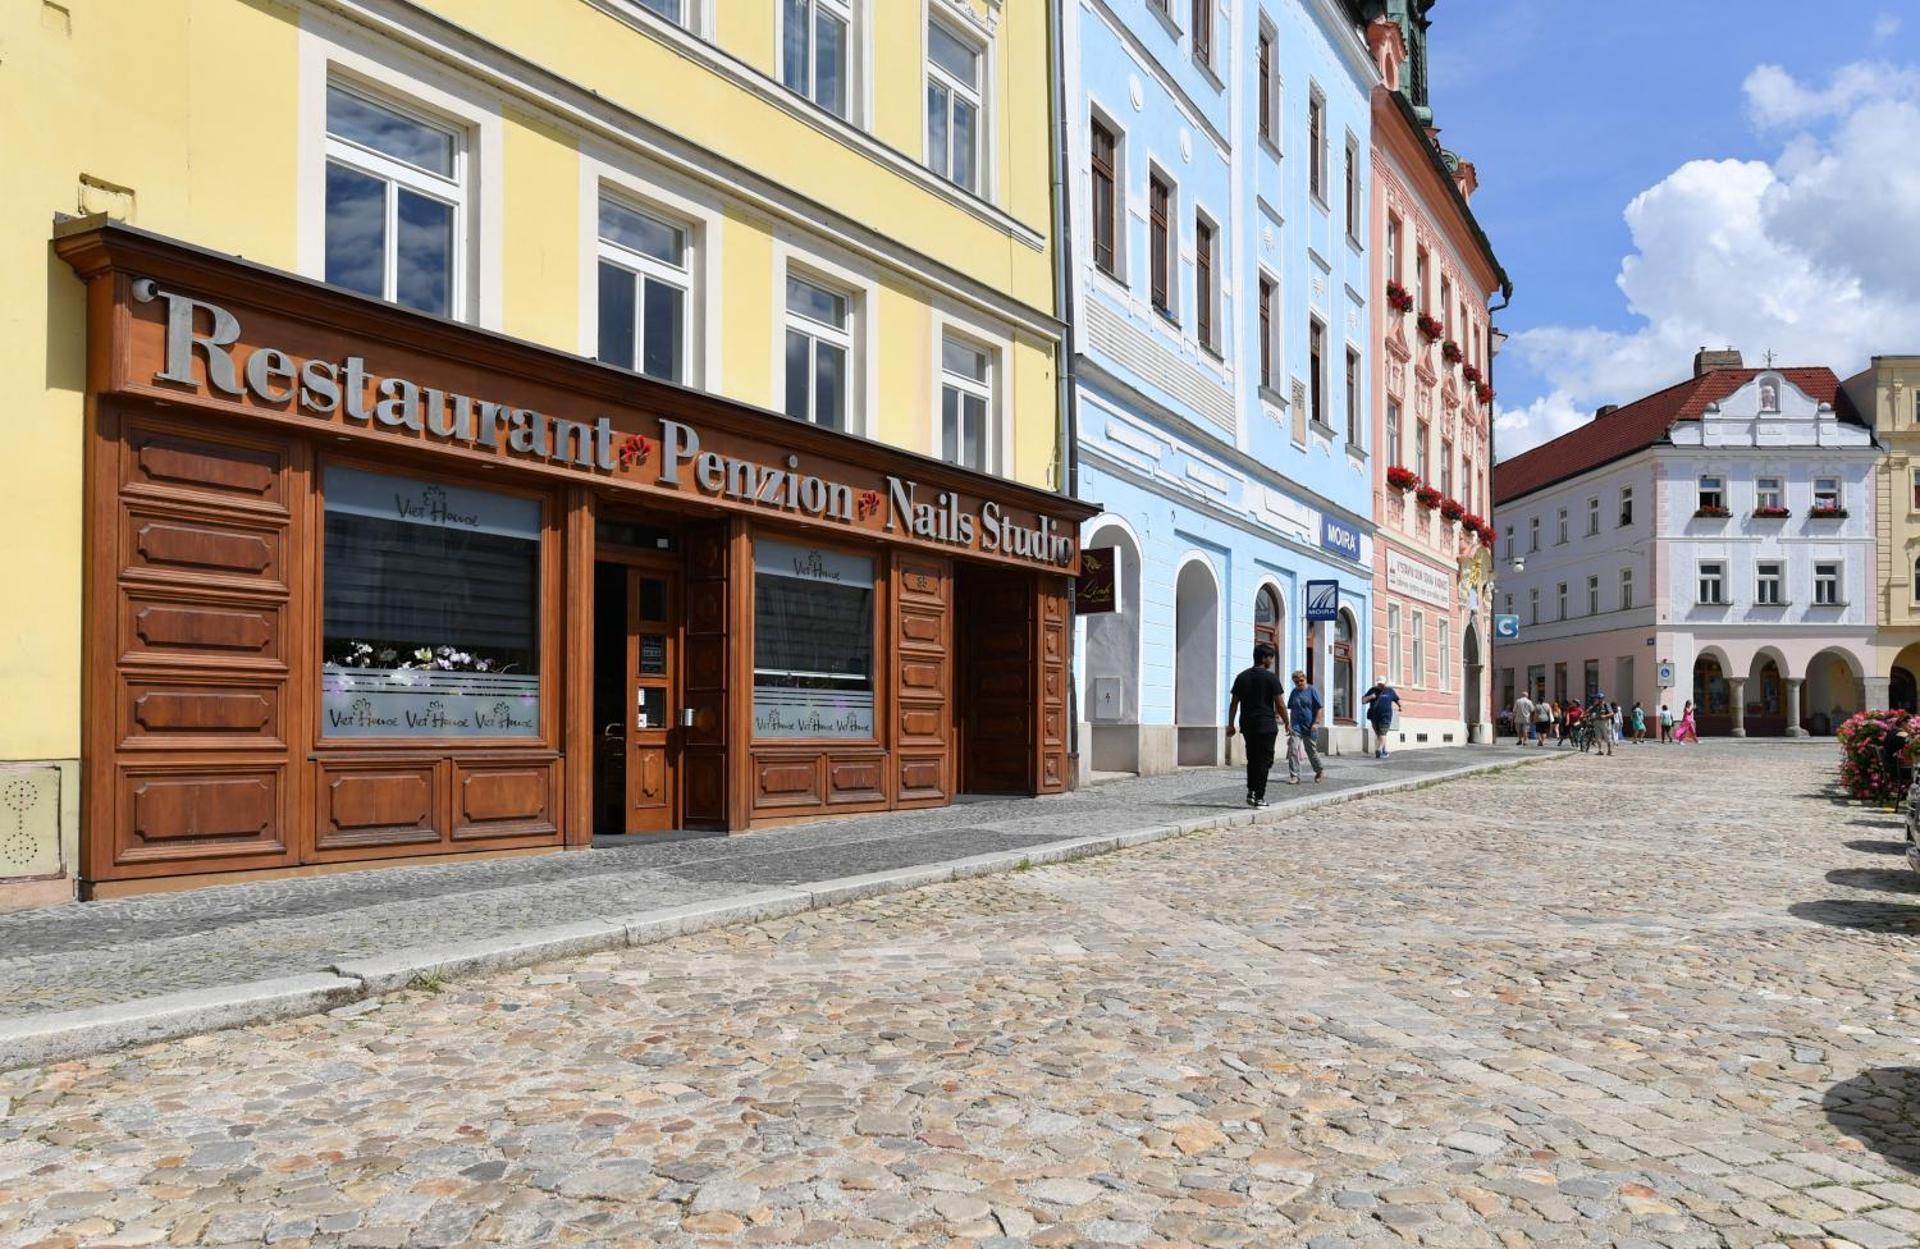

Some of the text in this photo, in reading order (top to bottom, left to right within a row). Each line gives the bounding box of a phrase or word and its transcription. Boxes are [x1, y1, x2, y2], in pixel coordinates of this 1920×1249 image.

[155, 291, 1074, 566] Restaurant Penzion Nails Studio
[1328, 523, 1356, 553] MOIRA
[1308, 608, 1336, 616] MOIRA
